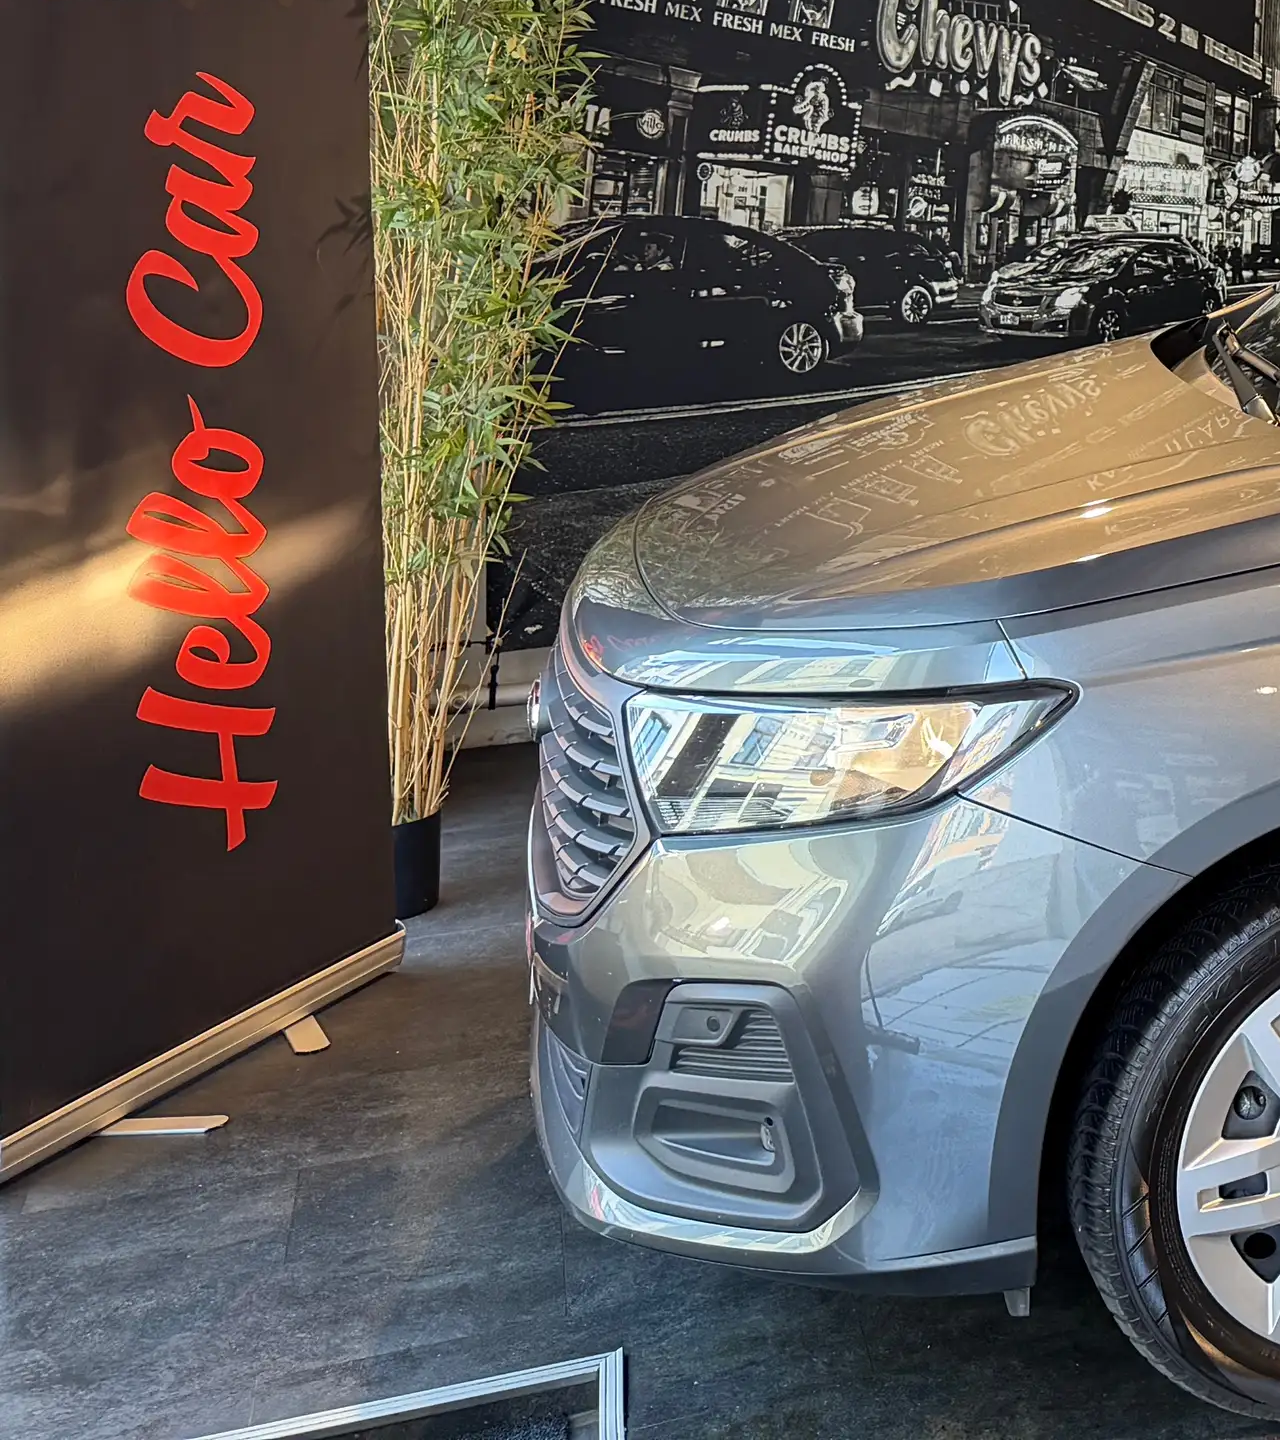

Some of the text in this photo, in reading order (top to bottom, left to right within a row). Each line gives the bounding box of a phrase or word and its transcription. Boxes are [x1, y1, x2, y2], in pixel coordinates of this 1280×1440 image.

[665, 0, 702, 23] MEX
[712, 11, 763, 36] FRESH
[769, 22, 802, 43] MEX
[811, 31, 856, 53] FRESH
[709, 129, 760, 144] CRUMBS
[773, 124, 850, 154] CRUMBS
[773, 141, 848, 163] BAKE SHOP
[125, 69, 256, 368] Car
[123, 394, 277, 851] Hello
